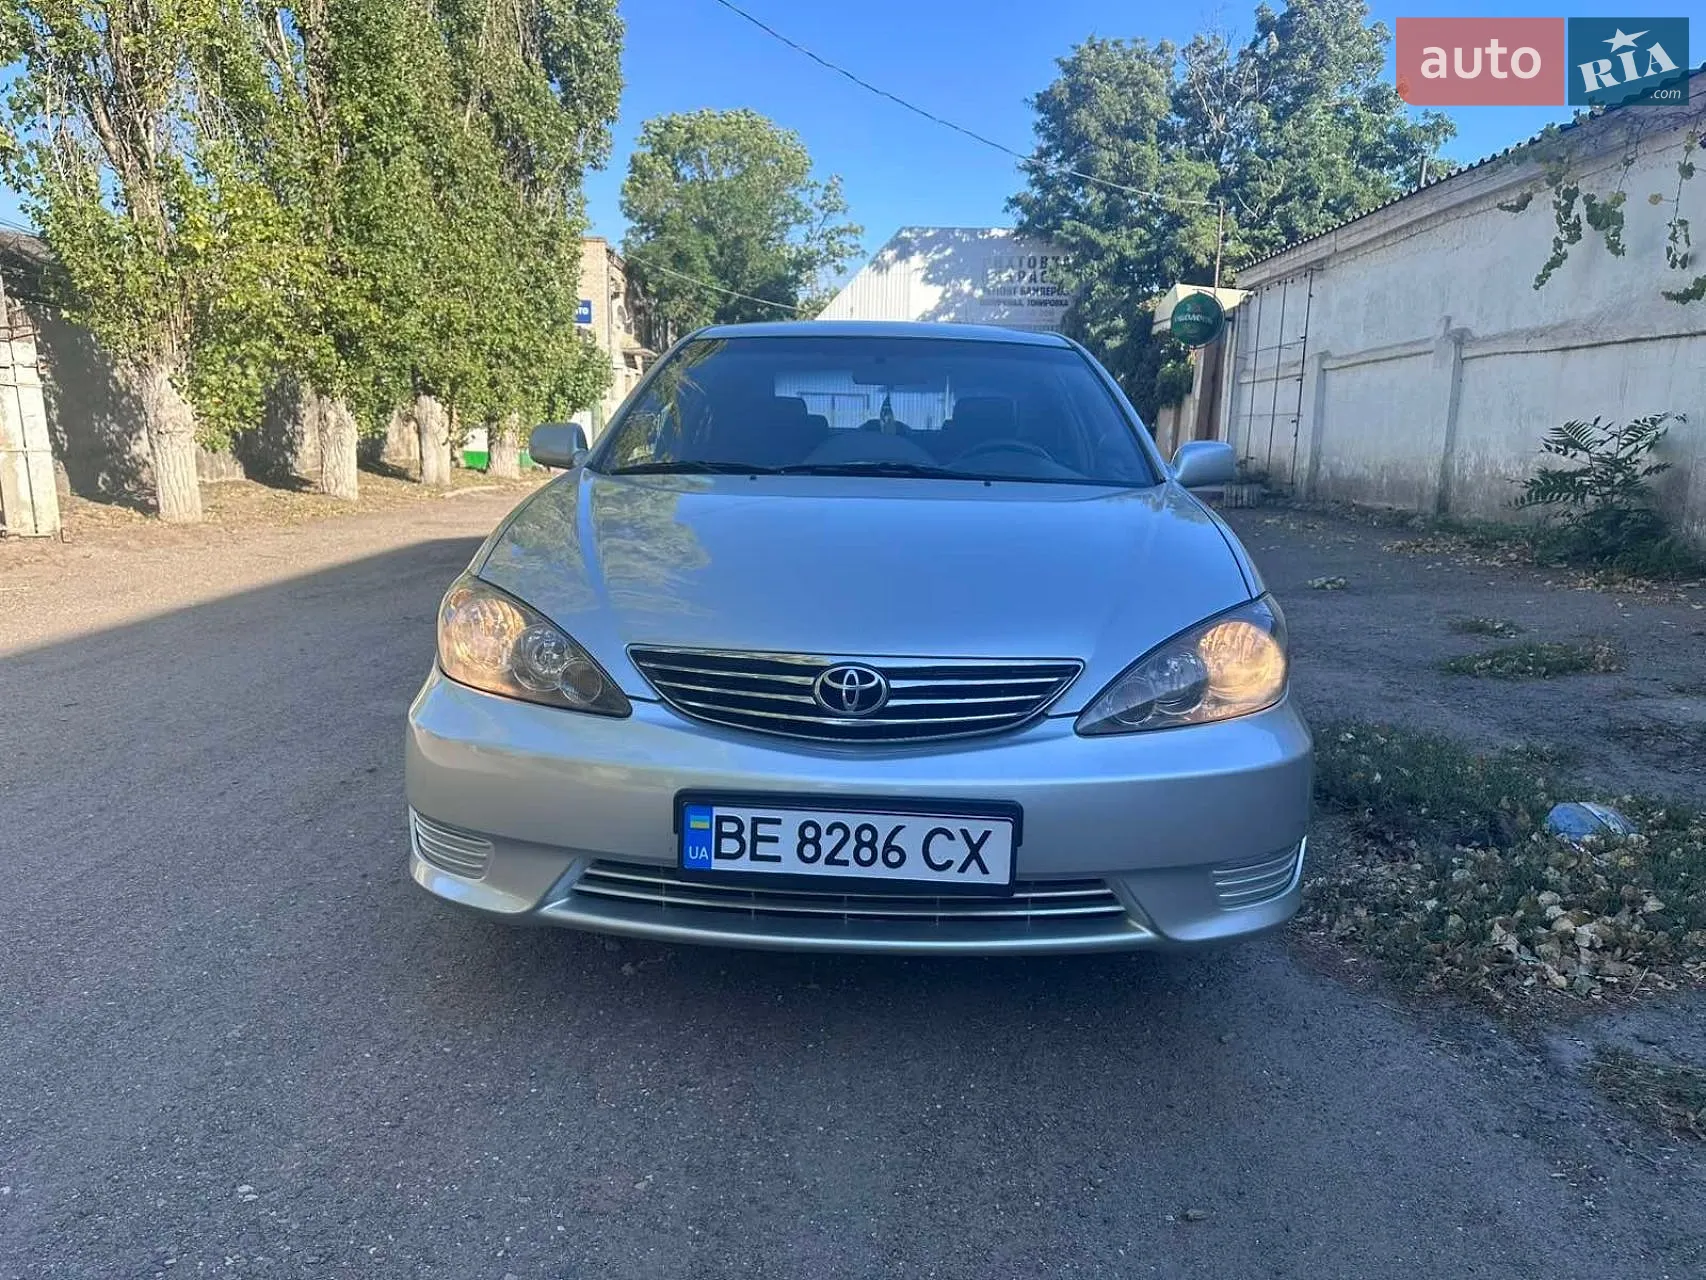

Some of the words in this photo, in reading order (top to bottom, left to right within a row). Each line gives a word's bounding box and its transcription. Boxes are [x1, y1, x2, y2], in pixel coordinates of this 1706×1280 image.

[689, 846, 709, 860] UA
[714, 815, 782, 863] BE
[796, 819, 907, 869] 8286
[921, 826, 993, 875] CX
